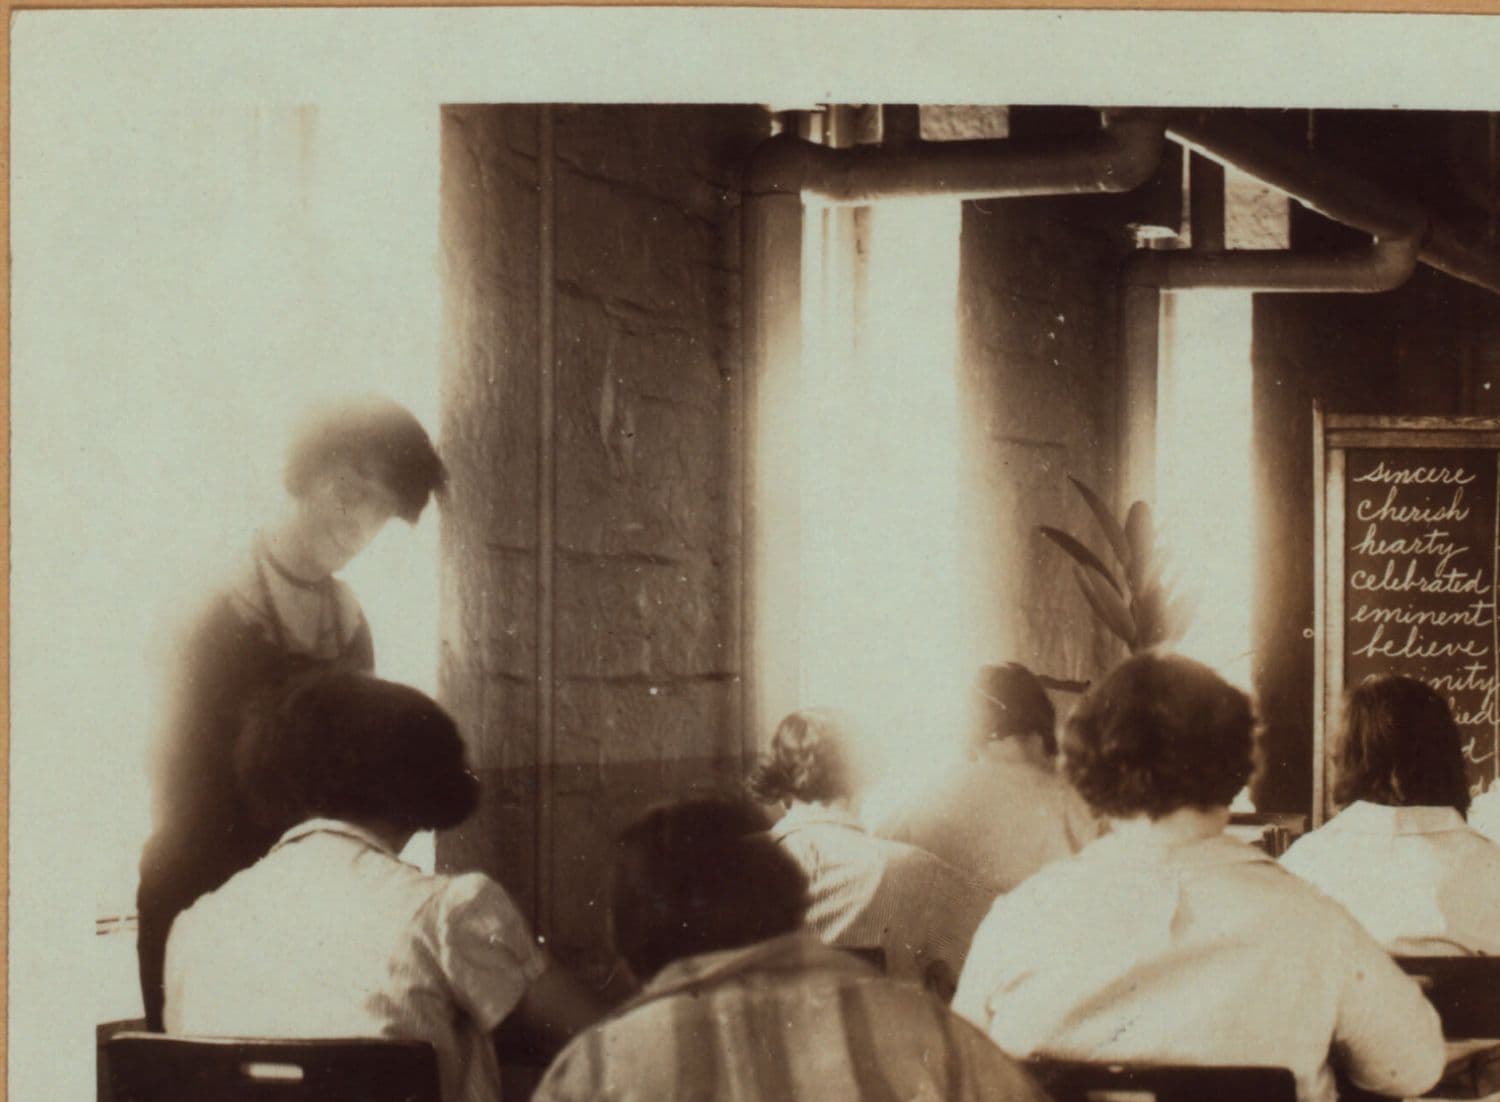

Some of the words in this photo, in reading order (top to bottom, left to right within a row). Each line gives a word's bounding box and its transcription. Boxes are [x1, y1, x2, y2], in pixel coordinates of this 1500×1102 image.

[1354, 462, 1475, 484] sincere
[1352, 523, 1470, 577] hearty
[1351, 559, 1491, 594] celebrated
[1352, 600, 1494, 626] eminent
[1353, 624, 1488, 657] believe
